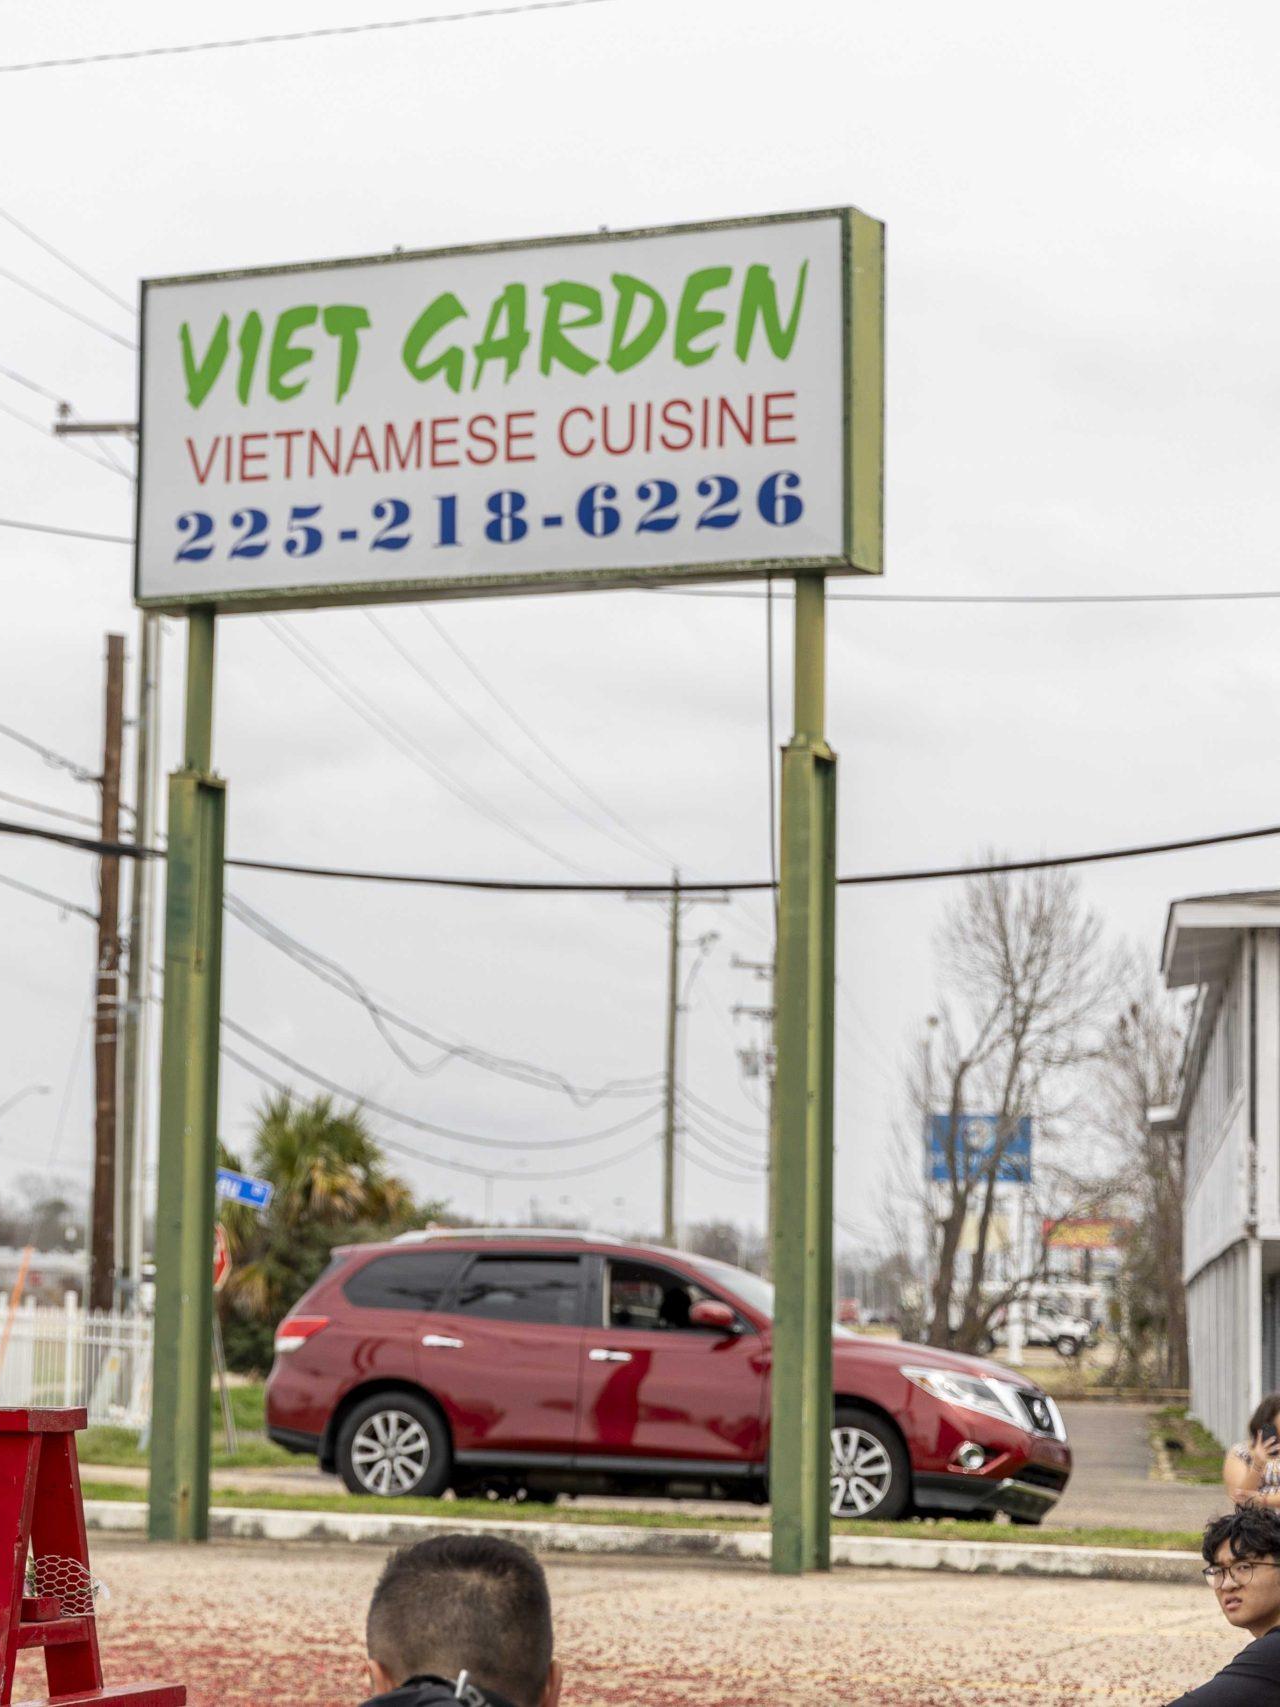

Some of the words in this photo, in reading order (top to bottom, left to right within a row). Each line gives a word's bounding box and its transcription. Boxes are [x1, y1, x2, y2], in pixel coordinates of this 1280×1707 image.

[180, 304, 371, 408] VIET
[402, 259, 808, 393] GARDEN
[186, 410, 536, 485] VIETNAMESE
[556, 391, 797, 458] CUISINE
[175, 472, 805, 562] 225-218-6226
